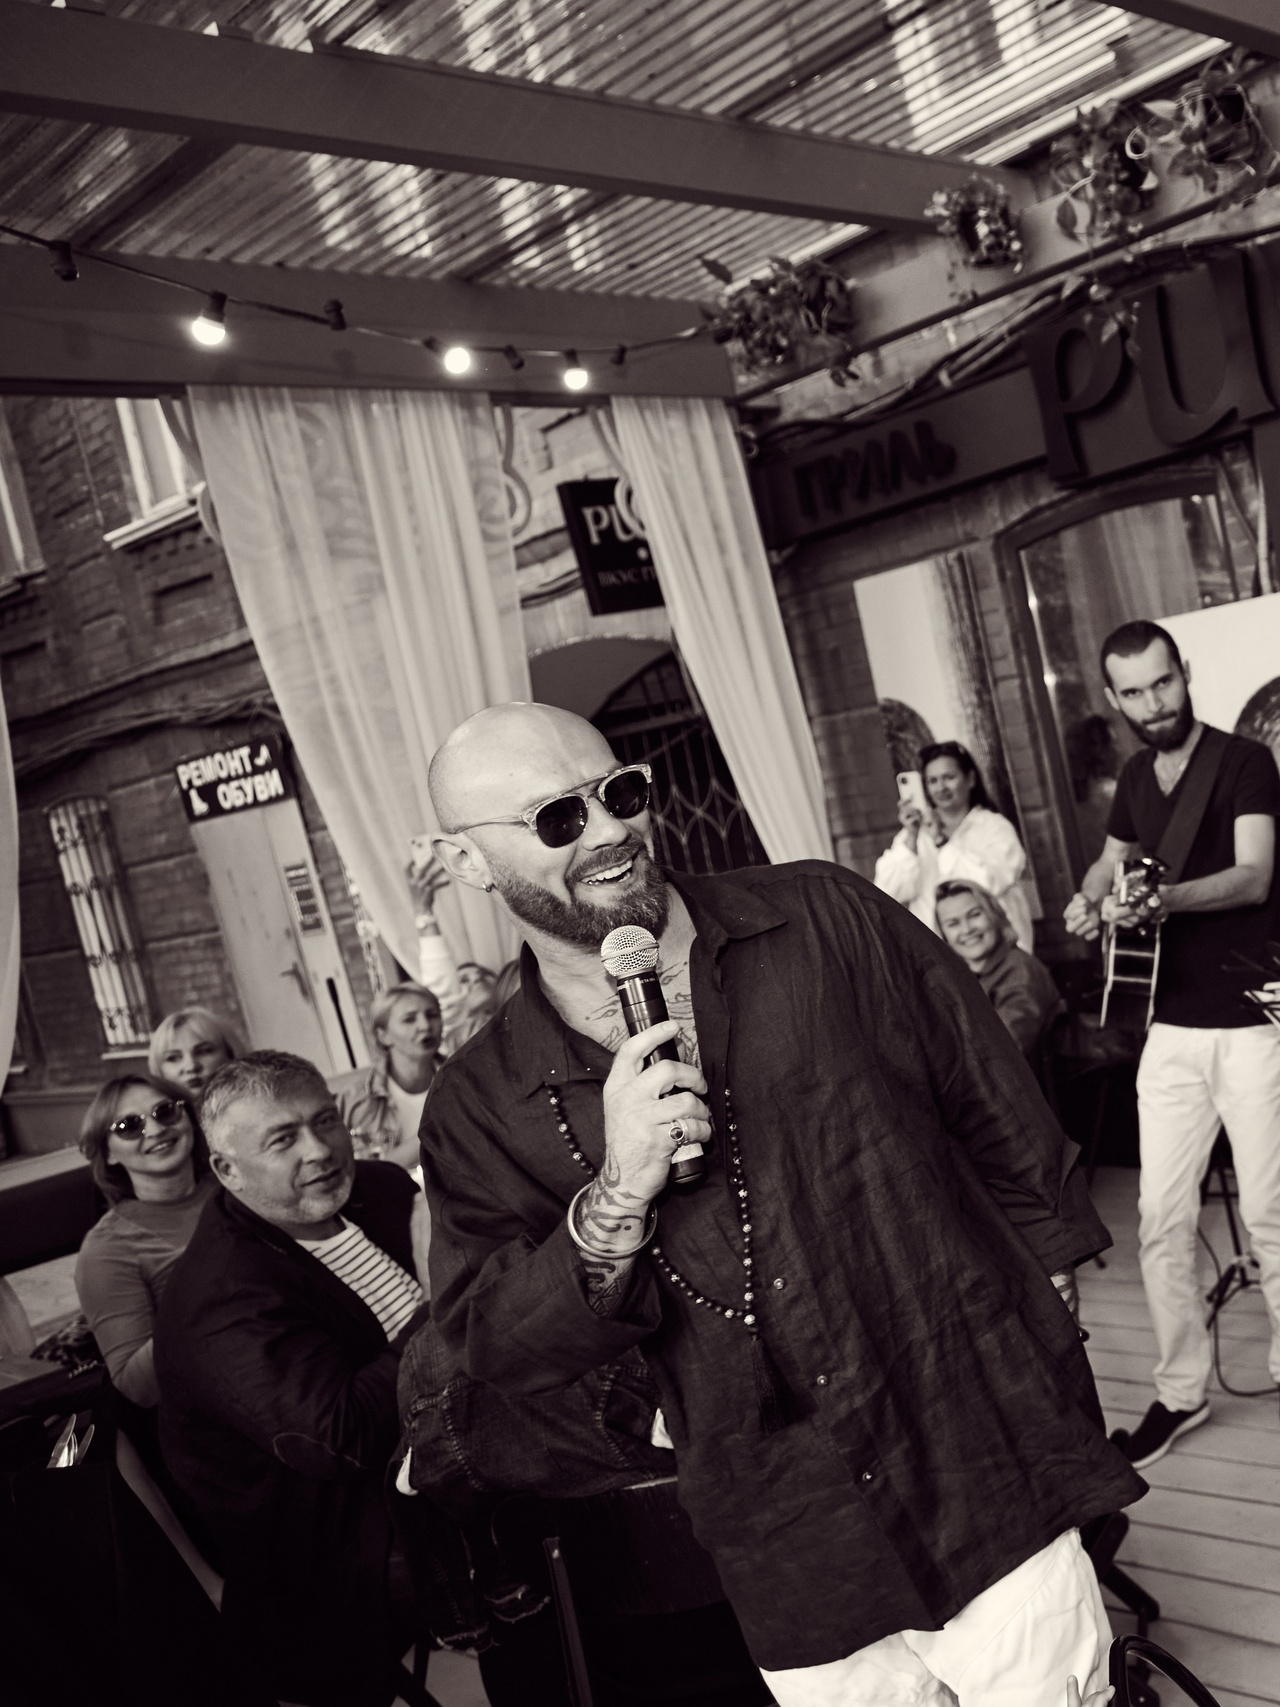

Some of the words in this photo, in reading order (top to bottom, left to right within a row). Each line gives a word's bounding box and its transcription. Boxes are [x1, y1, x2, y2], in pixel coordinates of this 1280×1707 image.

[793, 420, 957, 520] ГРИЛЬ
[581, 503, 642, 545] PU
[177, 745, 253, 790] РЕМОНТ
[217, 768, 284, 810] ОБУВИ
